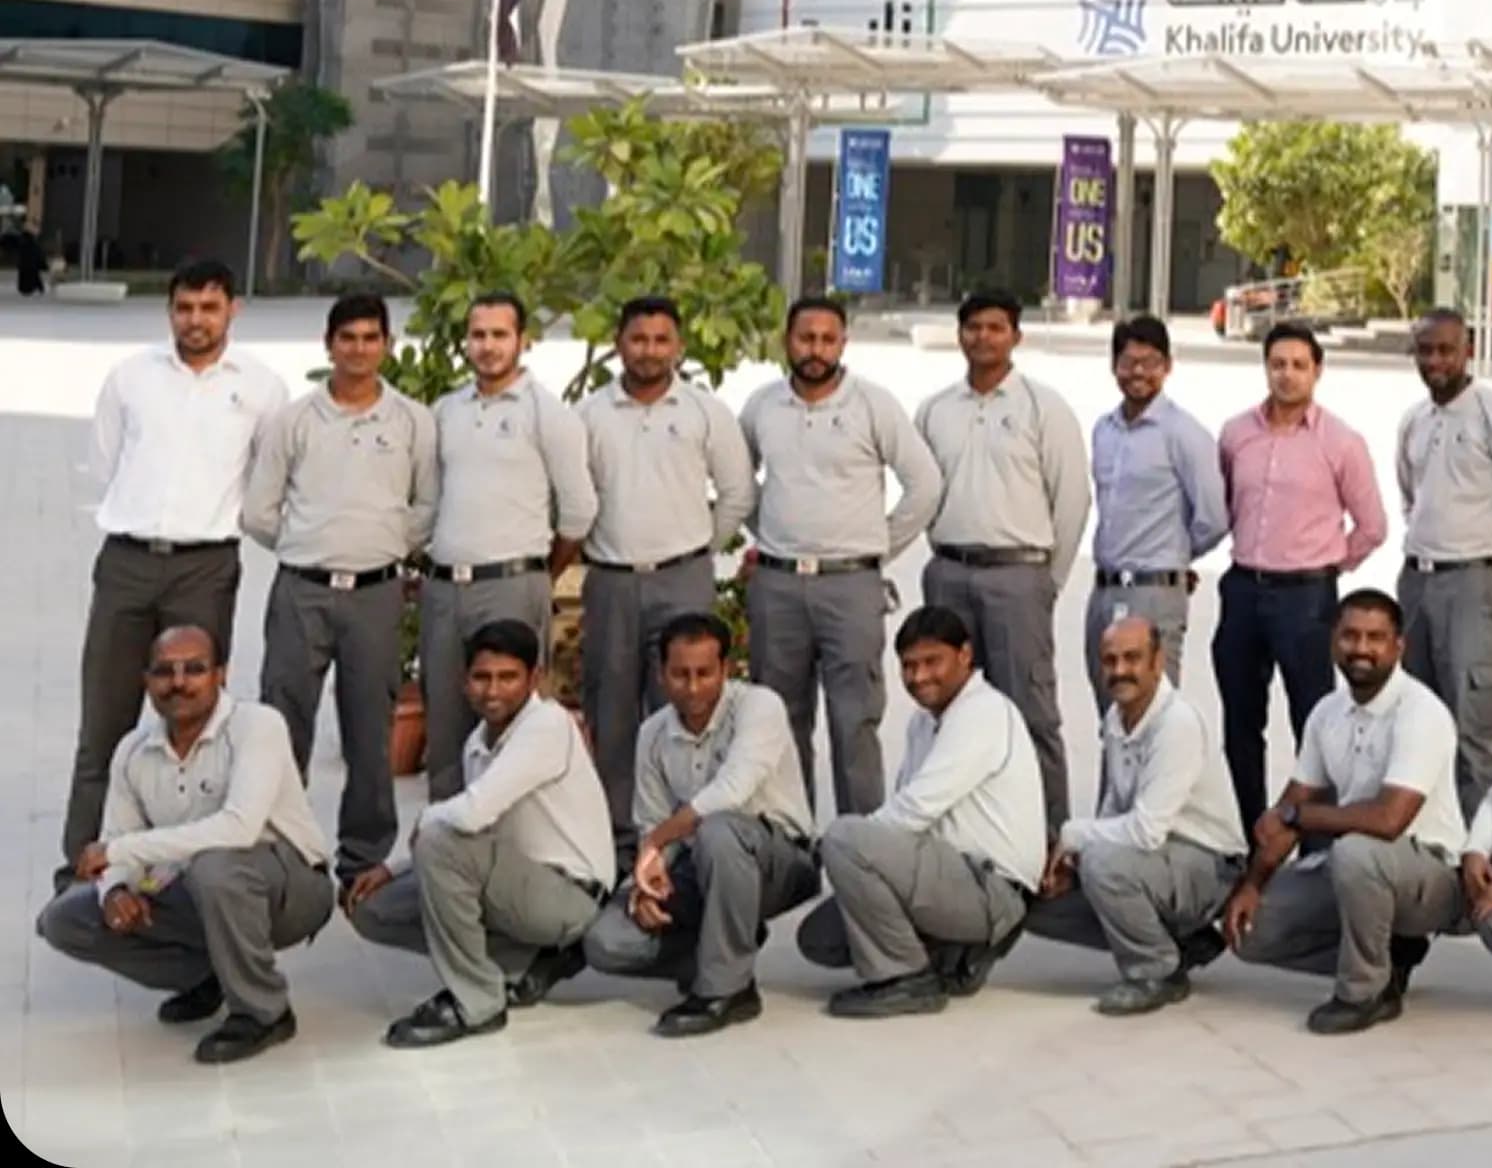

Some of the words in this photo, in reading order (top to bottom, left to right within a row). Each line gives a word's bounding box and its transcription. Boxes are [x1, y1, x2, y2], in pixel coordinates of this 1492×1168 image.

[1164, 22, 1264, 54] Khalifa
[1270, 21, 1425, 61] University
[847, 171, 880, 200] ONE
[1069, 176, 1105, 206] ONE
[844, 215, 878, 256] US
[1065, 220, 1104, 263] US
